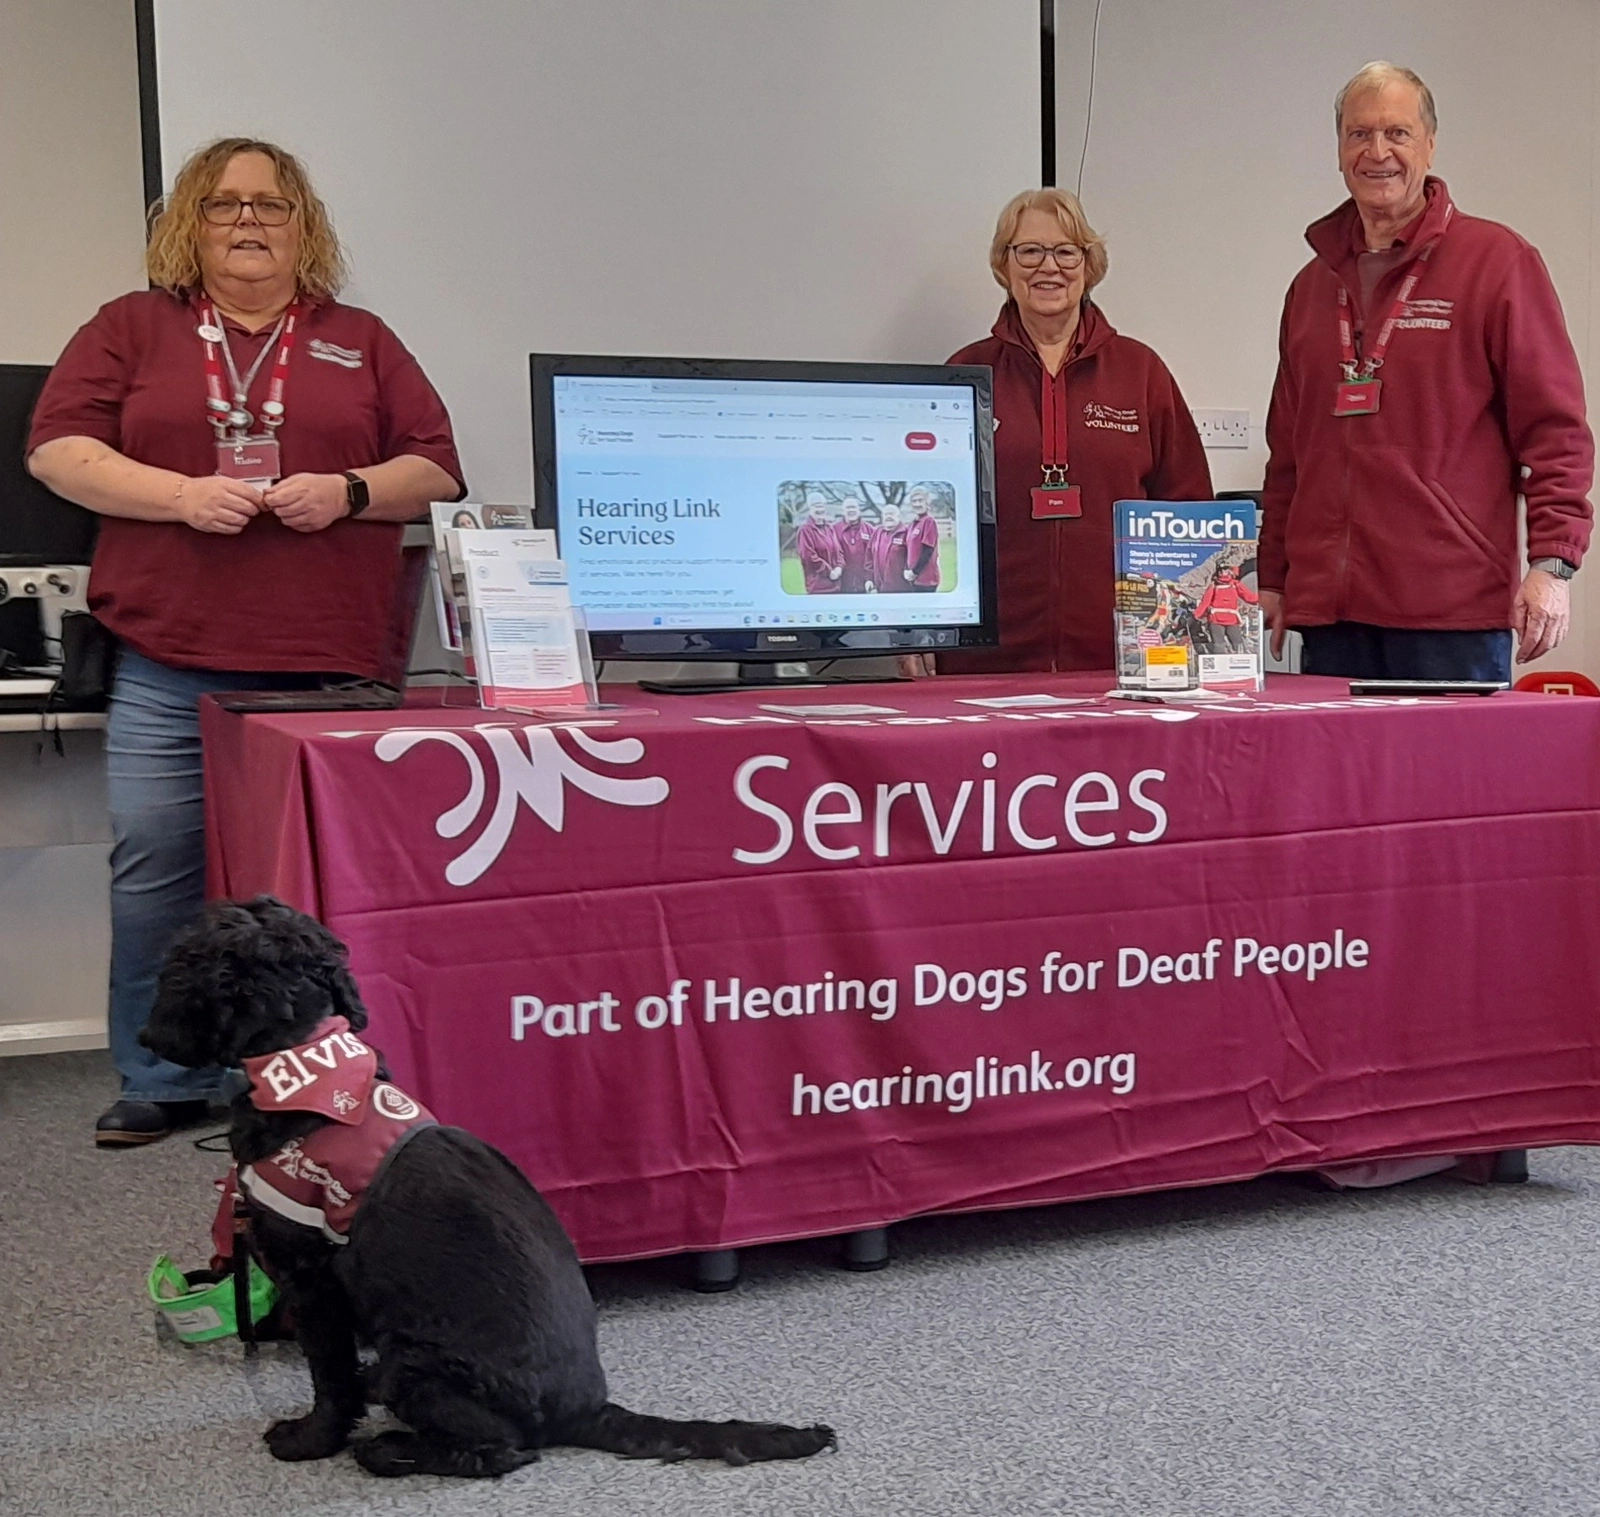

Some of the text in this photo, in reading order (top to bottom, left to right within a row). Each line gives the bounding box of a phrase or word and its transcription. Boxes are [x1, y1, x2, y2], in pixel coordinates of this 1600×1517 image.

[1084, 420, 1139, 432] VOLUNTEER
[577, 498, 721, 523] Hearing Link
[1129, 511, 1244, 539] inTouch
[578, 525, 675, 545] Services
[732, 751, 1169, 865] Services
[511, 929, 1369, 1041] Part of Hearing Dogs for Deaf People
[260, 1031, 369, 1103] Elvis
[791, 1050, 1136, 1116] hearinglink.org
